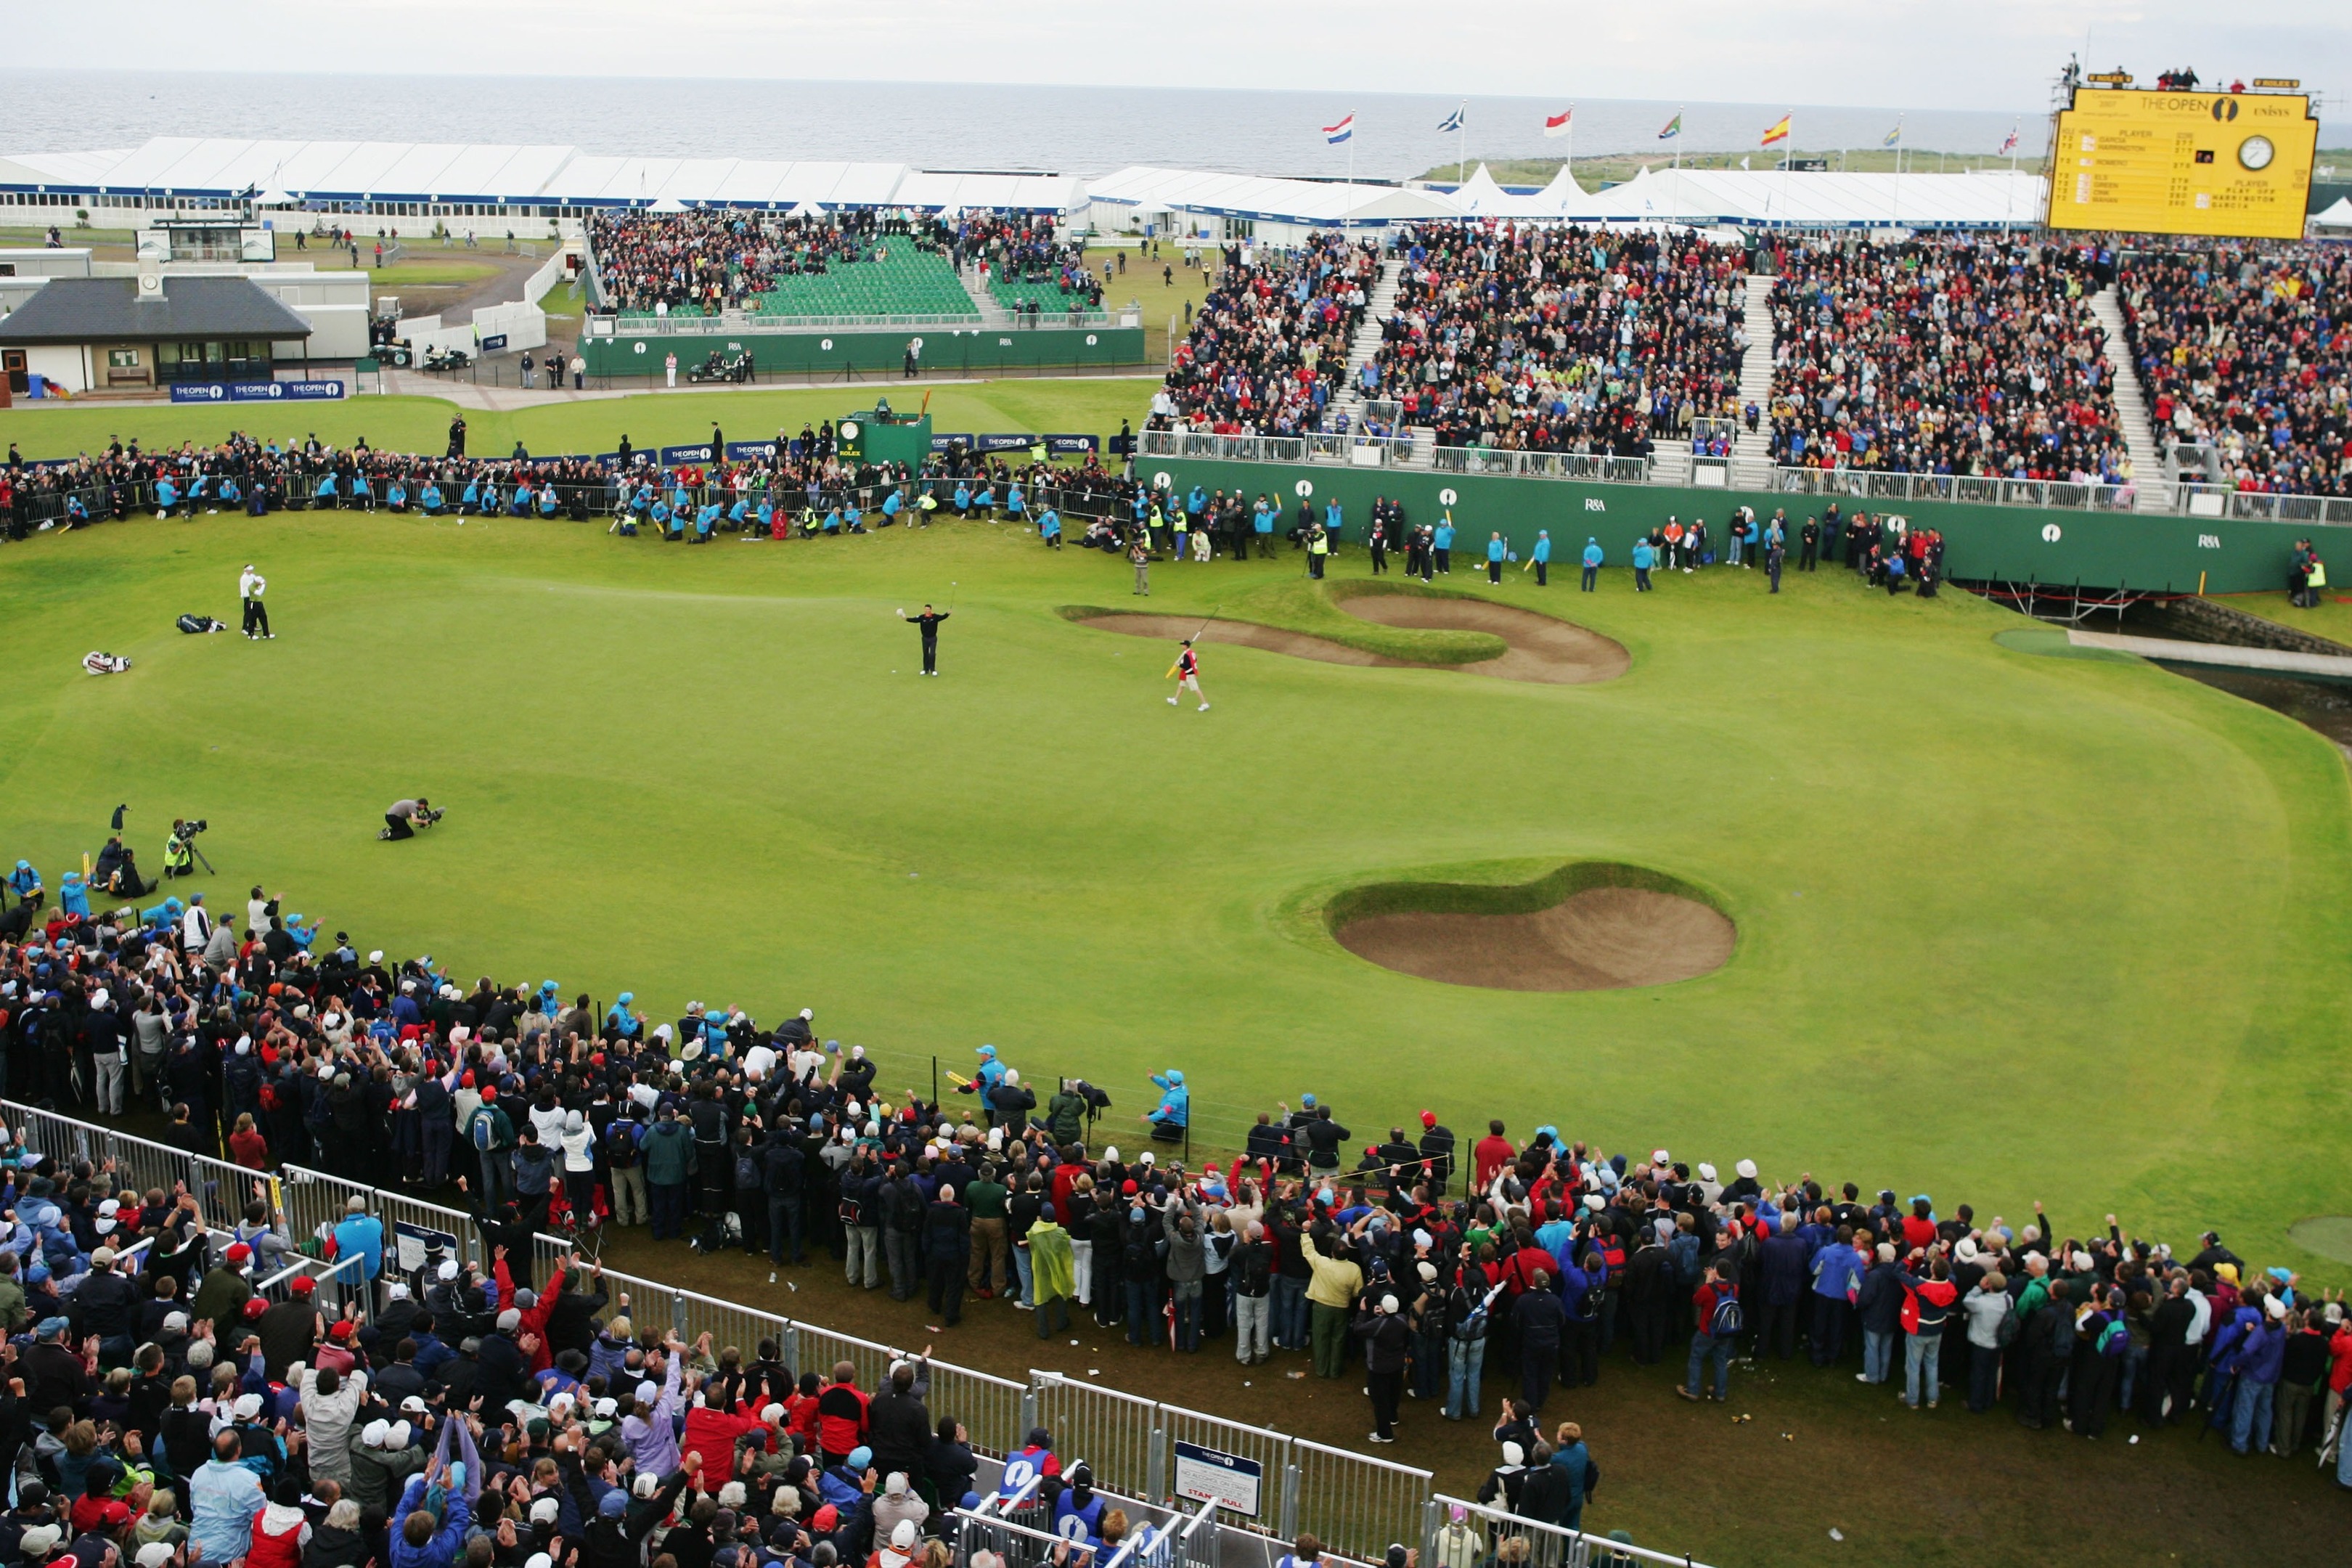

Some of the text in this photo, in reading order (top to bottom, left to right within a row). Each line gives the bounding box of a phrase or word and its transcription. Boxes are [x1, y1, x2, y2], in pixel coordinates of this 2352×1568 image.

[2141, 97, 2209, 112] THE OPEN
[728, 342, 741, 351] R&A
[1585, 498, 1606, 511] R&A
[2198, 534, 2220, 549] R&A
[1192, 1472, 1217, 1484] ALCOHOL
[1231, 1483, 1251, 1493] STANDS
[1188, 1488, 1243, 1508] STAN FULL
